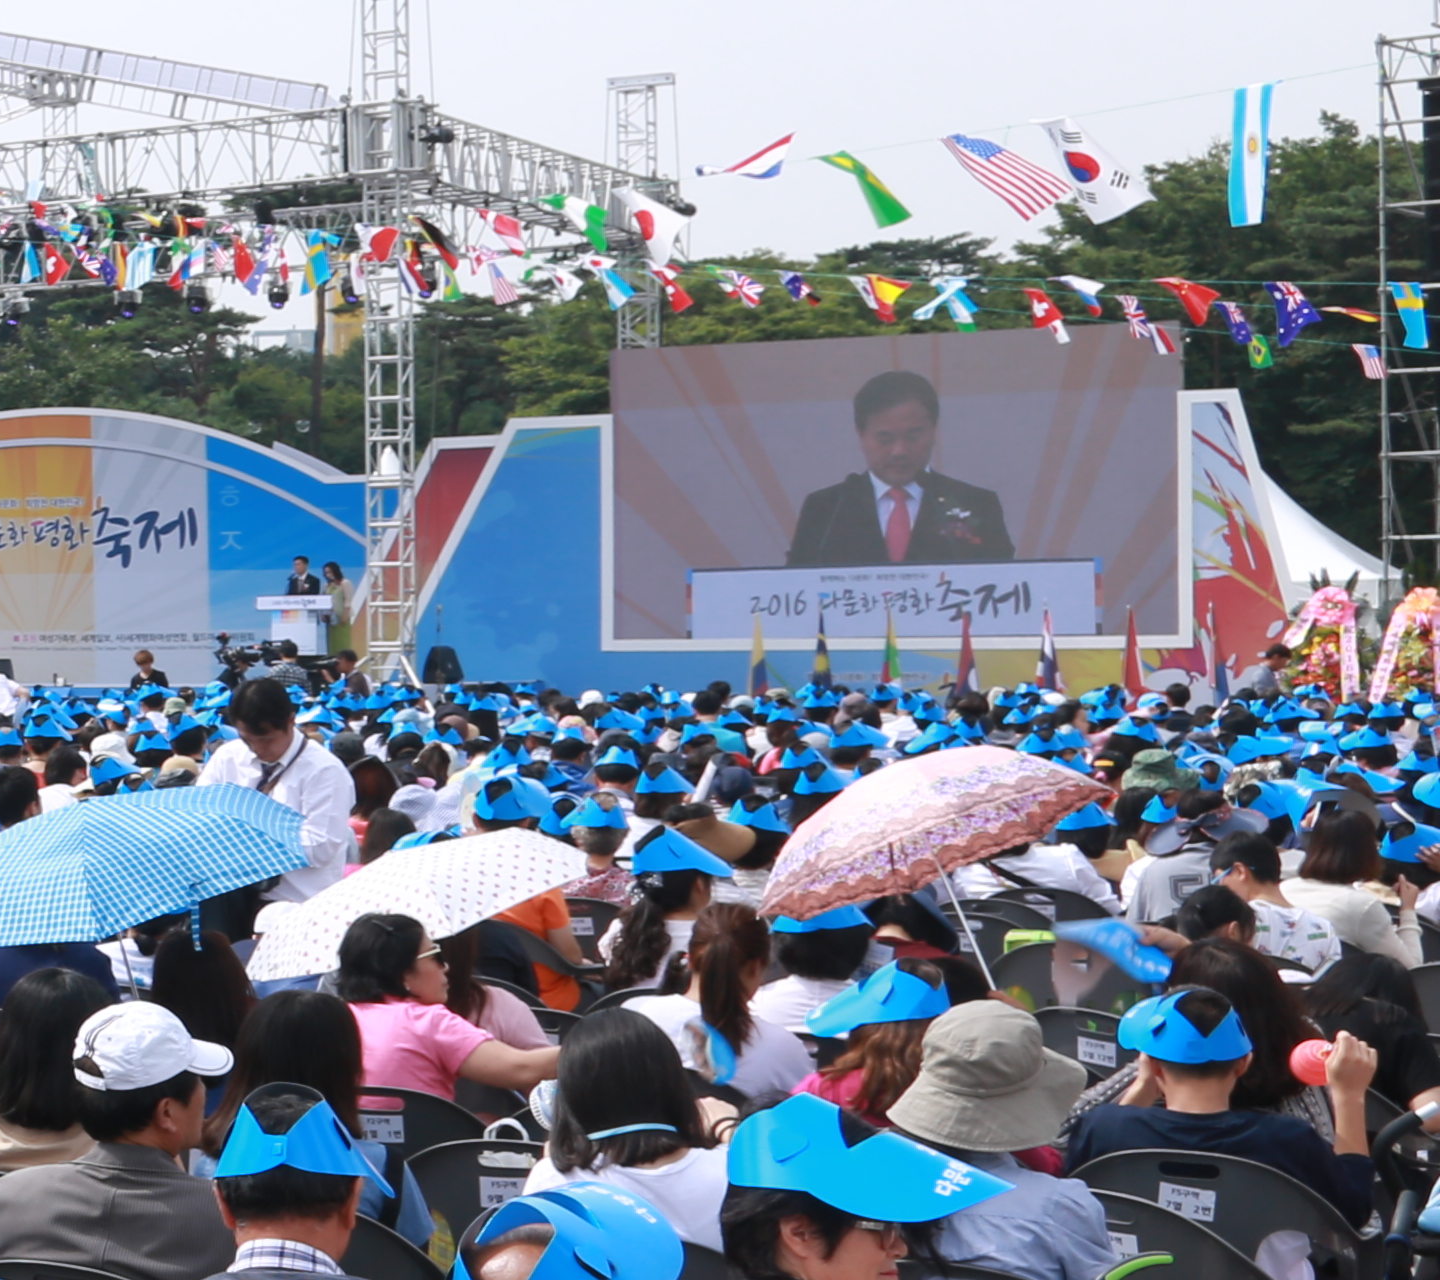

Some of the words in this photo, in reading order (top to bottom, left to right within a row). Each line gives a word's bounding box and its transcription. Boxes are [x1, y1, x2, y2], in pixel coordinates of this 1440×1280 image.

[30, 516, 90, 551] 평화
[91, 496, 199, 568] 축제
[750, 590, 807, 618] 2016
[818, 589, 880, 617] 다문화
[881, 588, 935, 616] 평화
[936, 571, 1032, 622] 축제
[1165, 1200, 1183, 1213] 7열
[1193, 1205, 1212, 1217] 2번
[1171, 1187, 1200, 1200] F5구역
